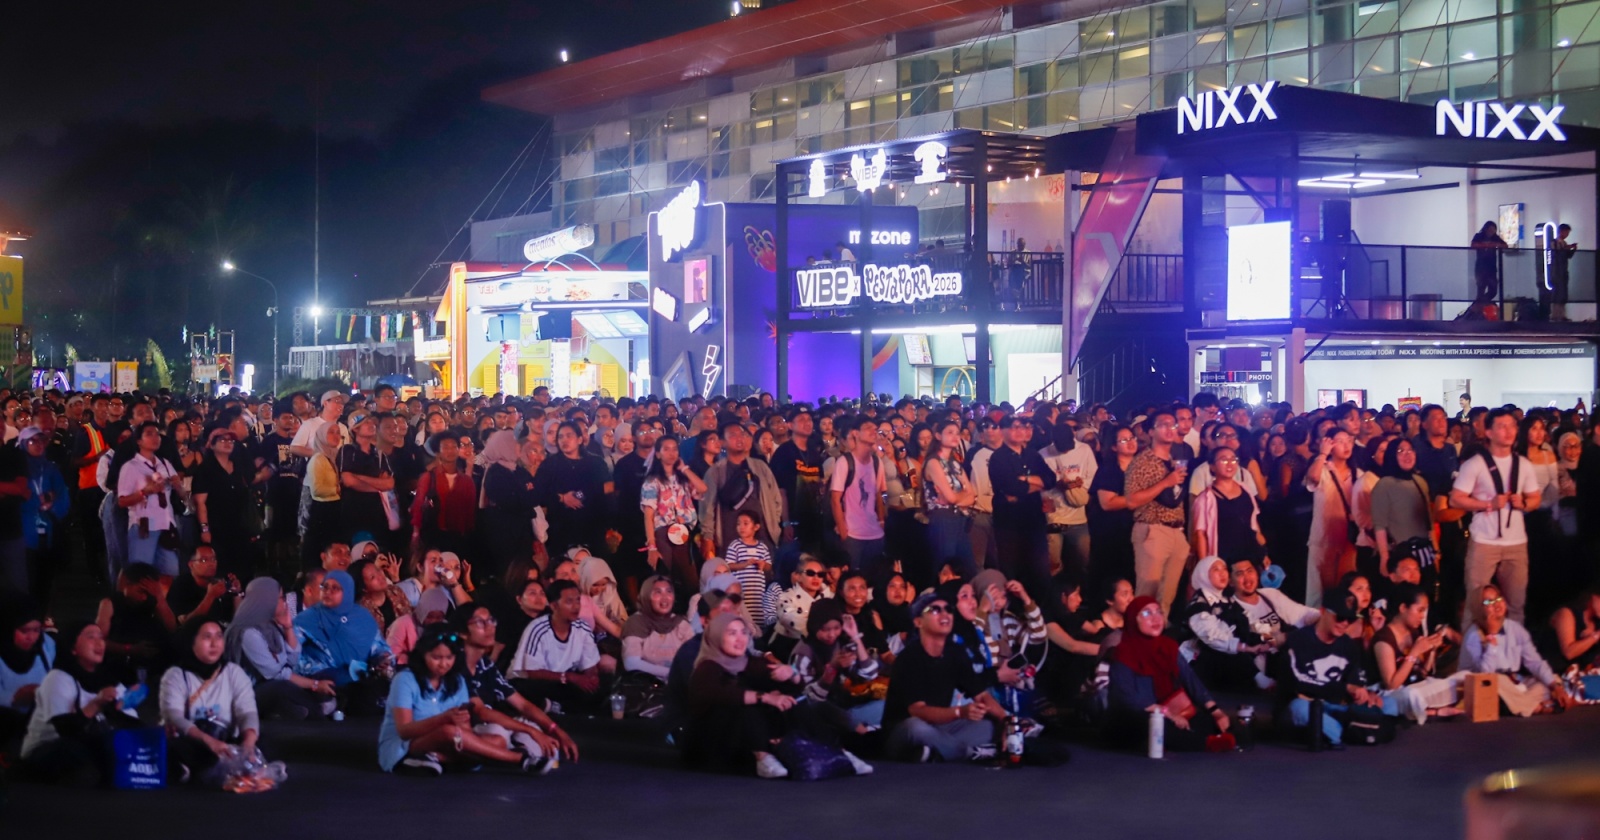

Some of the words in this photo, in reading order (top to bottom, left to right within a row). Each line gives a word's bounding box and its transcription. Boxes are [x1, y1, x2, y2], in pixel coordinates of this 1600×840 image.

[1177, 80, 1278, 134] NIXX
[1436, 99, 1567, 141] NIXX
[934, 276, 957, 291] 2026
